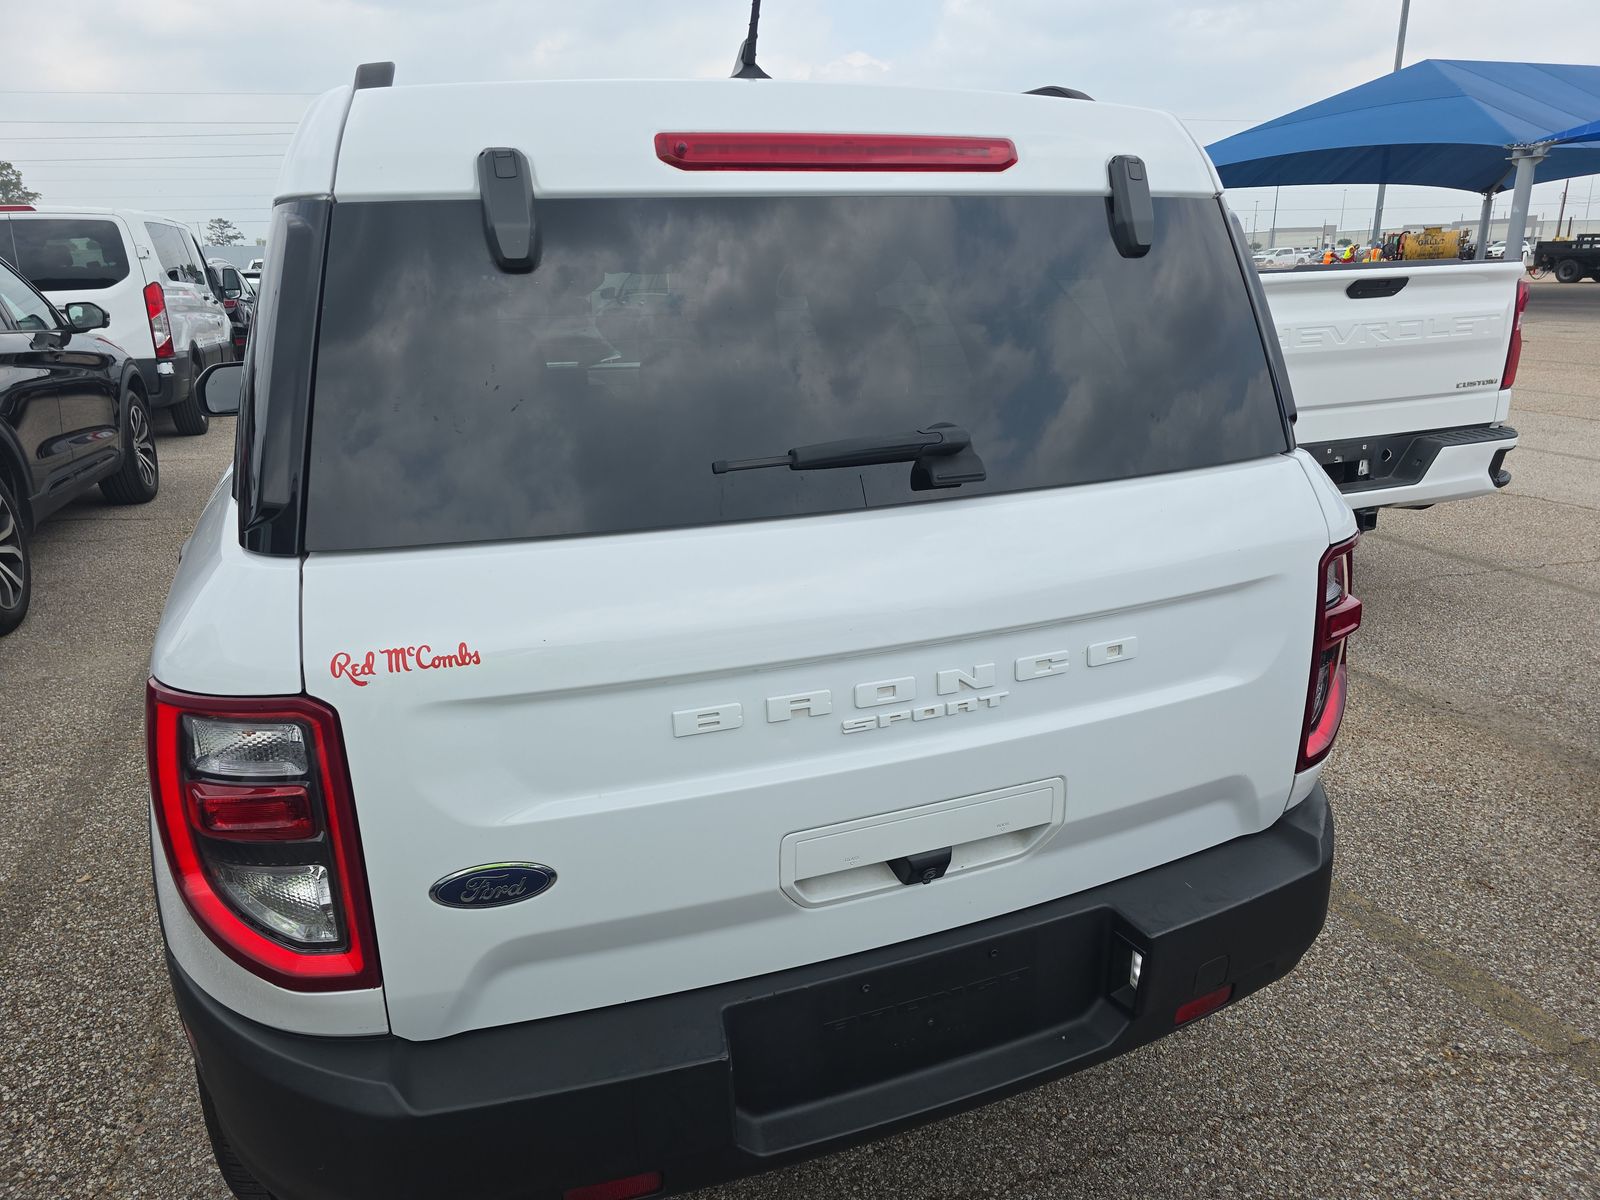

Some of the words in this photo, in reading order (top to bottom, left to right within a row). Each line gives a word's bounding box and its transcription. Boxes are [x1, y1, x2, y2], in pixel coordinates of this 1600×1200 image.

[1278, 314, 1501, 349] EVROLET
[1456, 379, 1498, 388] CUSTOM
[330, 651, 377, 687] Red
[379, 642, 481, 673] McCombs
[672, 636, 1138, 739] BRONCO
[842, 690, 1010, 734] SPORT
[460, 874, 527, 902] Ford
